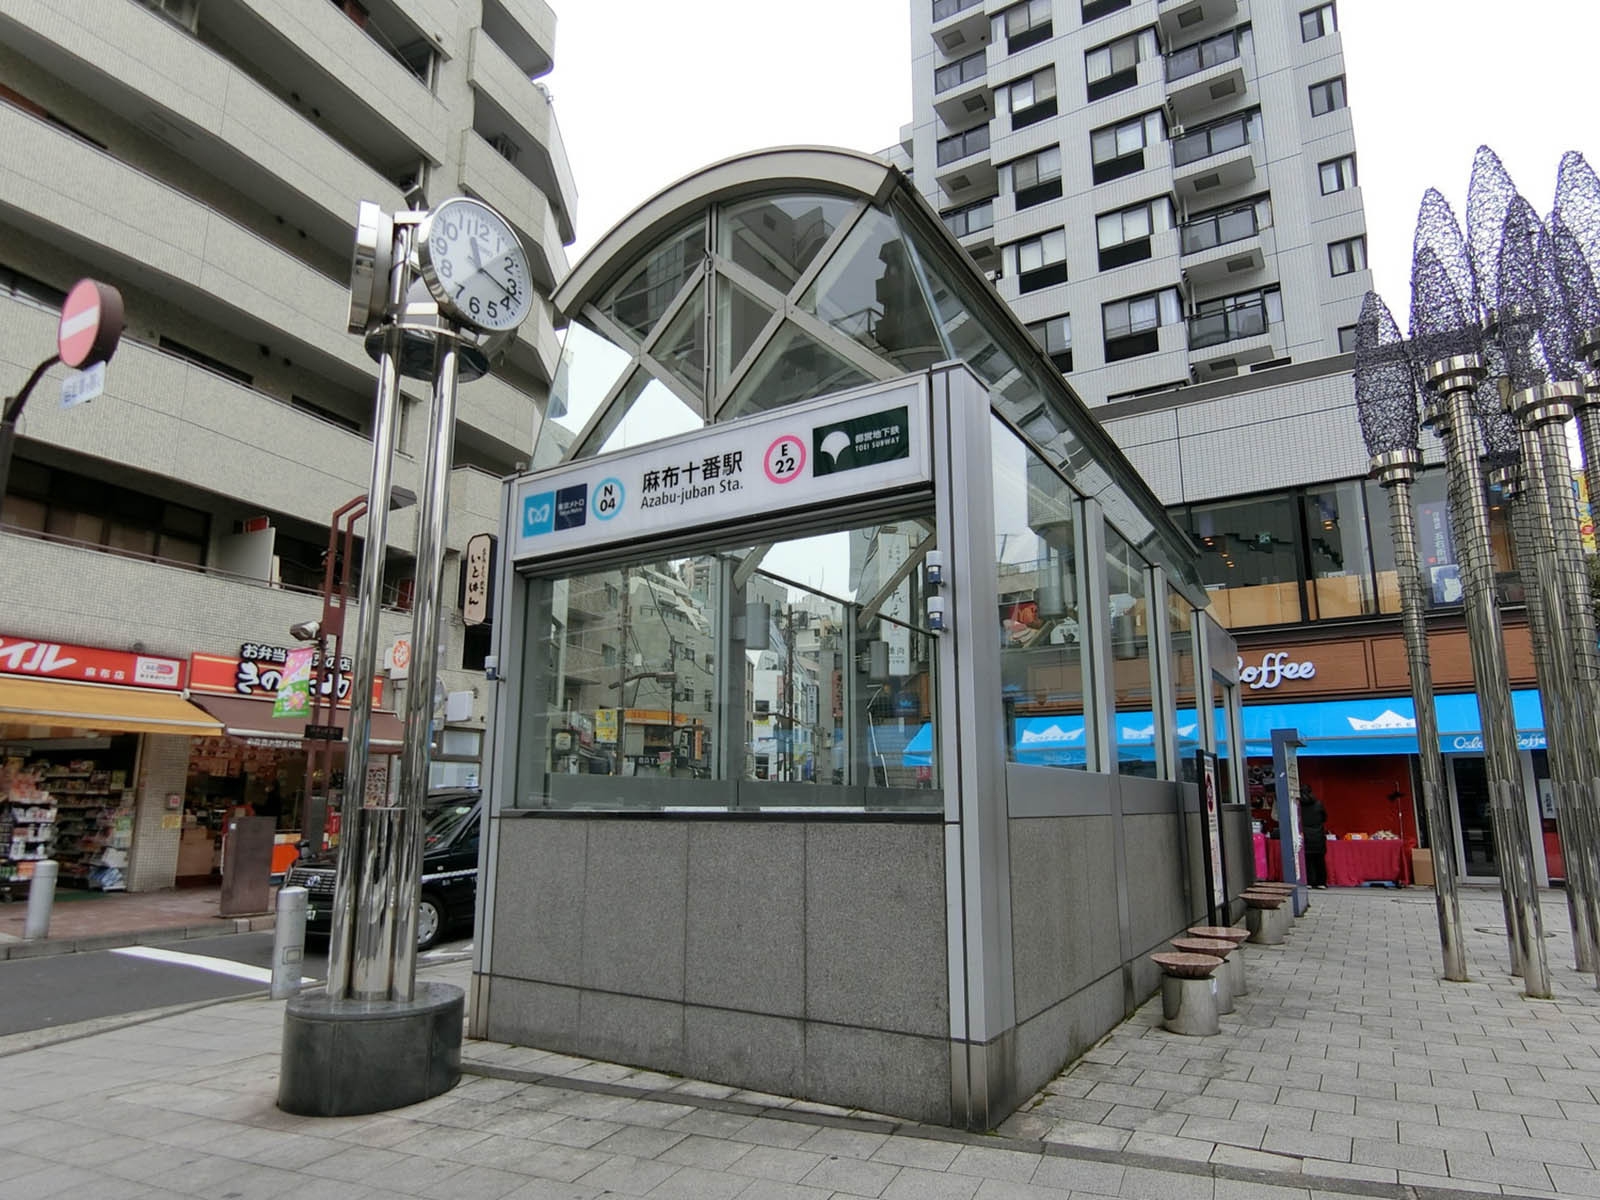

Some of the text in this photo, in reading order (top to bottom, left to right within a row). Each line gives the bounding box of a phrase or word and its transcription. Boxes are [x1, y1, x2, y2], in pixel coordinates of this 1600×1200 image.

[436, 237, 448, 256] 9
[440, 259, 453, 279] 8
[503, 256, 514, 275] 2
[454, 281, 465, 299] 7
[507, 278, 517, 296] 3
[469, 296, 480, 315] 6
[487, 300, 498, 319] 5
[500, 295, 511, 311] 4
[854, 425, 900, 443] 都営地下鉄
[781, 443, 789, 457] E
[855, 436, 900, 453] TOEI SUBWAY
[641, 450, 743, 494] 麻布十番駅
[775, 457, 795, 475] 22
[603, 484, 613, 497] N
[640, 479, 744, 510] Azabu-juban Sta.
[600, 498, 616, 512] 04
[0, 639, 77, 673] イル
